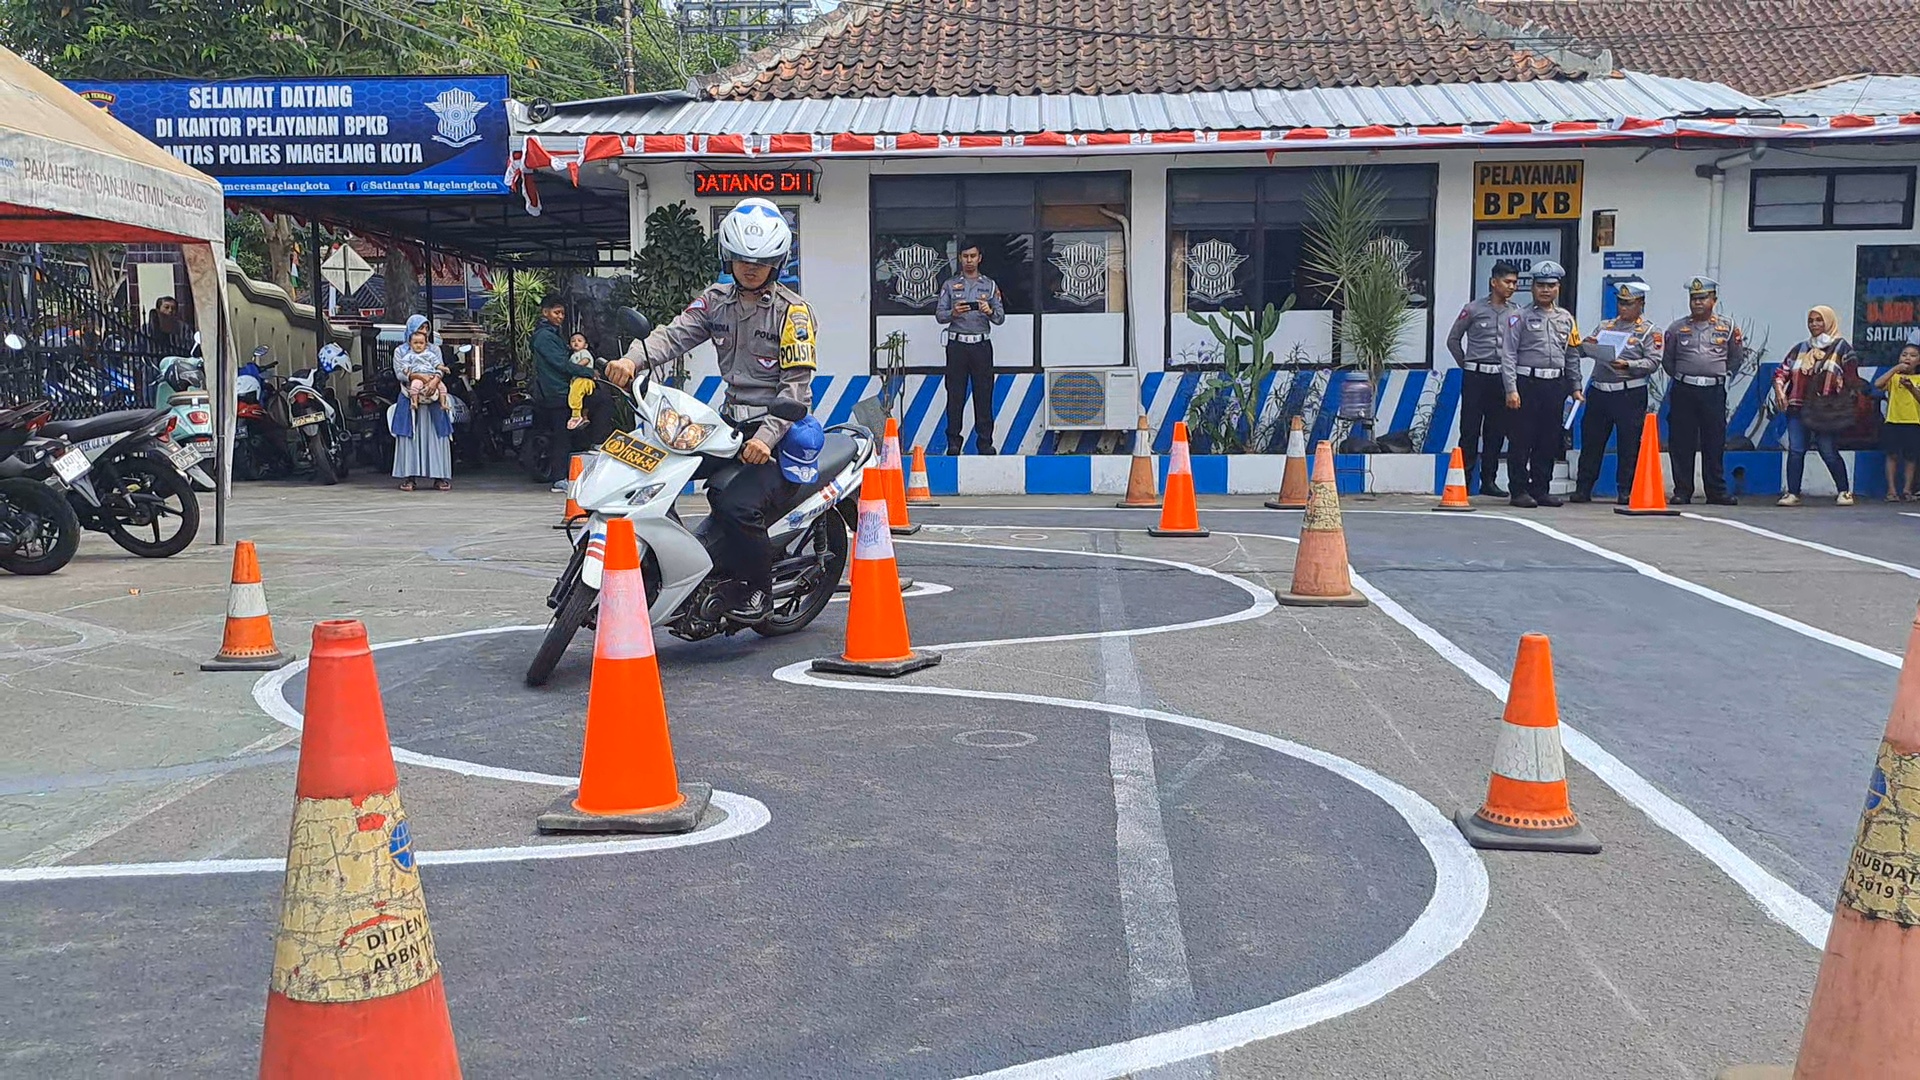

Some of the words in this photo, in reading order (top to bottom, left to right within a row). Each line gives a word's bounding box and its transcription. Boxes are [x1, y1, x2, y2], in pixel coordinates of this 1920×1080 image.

[189, 86, 275, 109] SELAMAT
[281, 85, 353, 108] DATANG
[156, 118, 173, 138] DI
[178, 117, 242, 138] KANTOR
[247, 116, 340, 137] PELAYANAN
[345, 115, 389, 136] BPKB
[219, 144, 281, 165] POLRES
[286, 143, 377, 164] MAGELANG
[381, 143, 424, 164] KOTA
[23, 156, 59, 185] PAKAI
[95, 172, 119, 198] DAN
[119, 179, 164, 207] JAKETMU
[361, 181, 421, 191] @Satlantas
[423, 180, 498, 193] Magelangkota
[1480, 164, 1577, 186] PELAYANAN
[1484, 191, 1571, 215] BPKB
[1477, 240, 1551, 256] PELAYANAN
[780, 344, 810, 366] POLISI
[1854, 849, 1920, 885] HUBDAT
[366, 914, 423, 951] DITJEN
[373, 941, 420, 974] APBN
